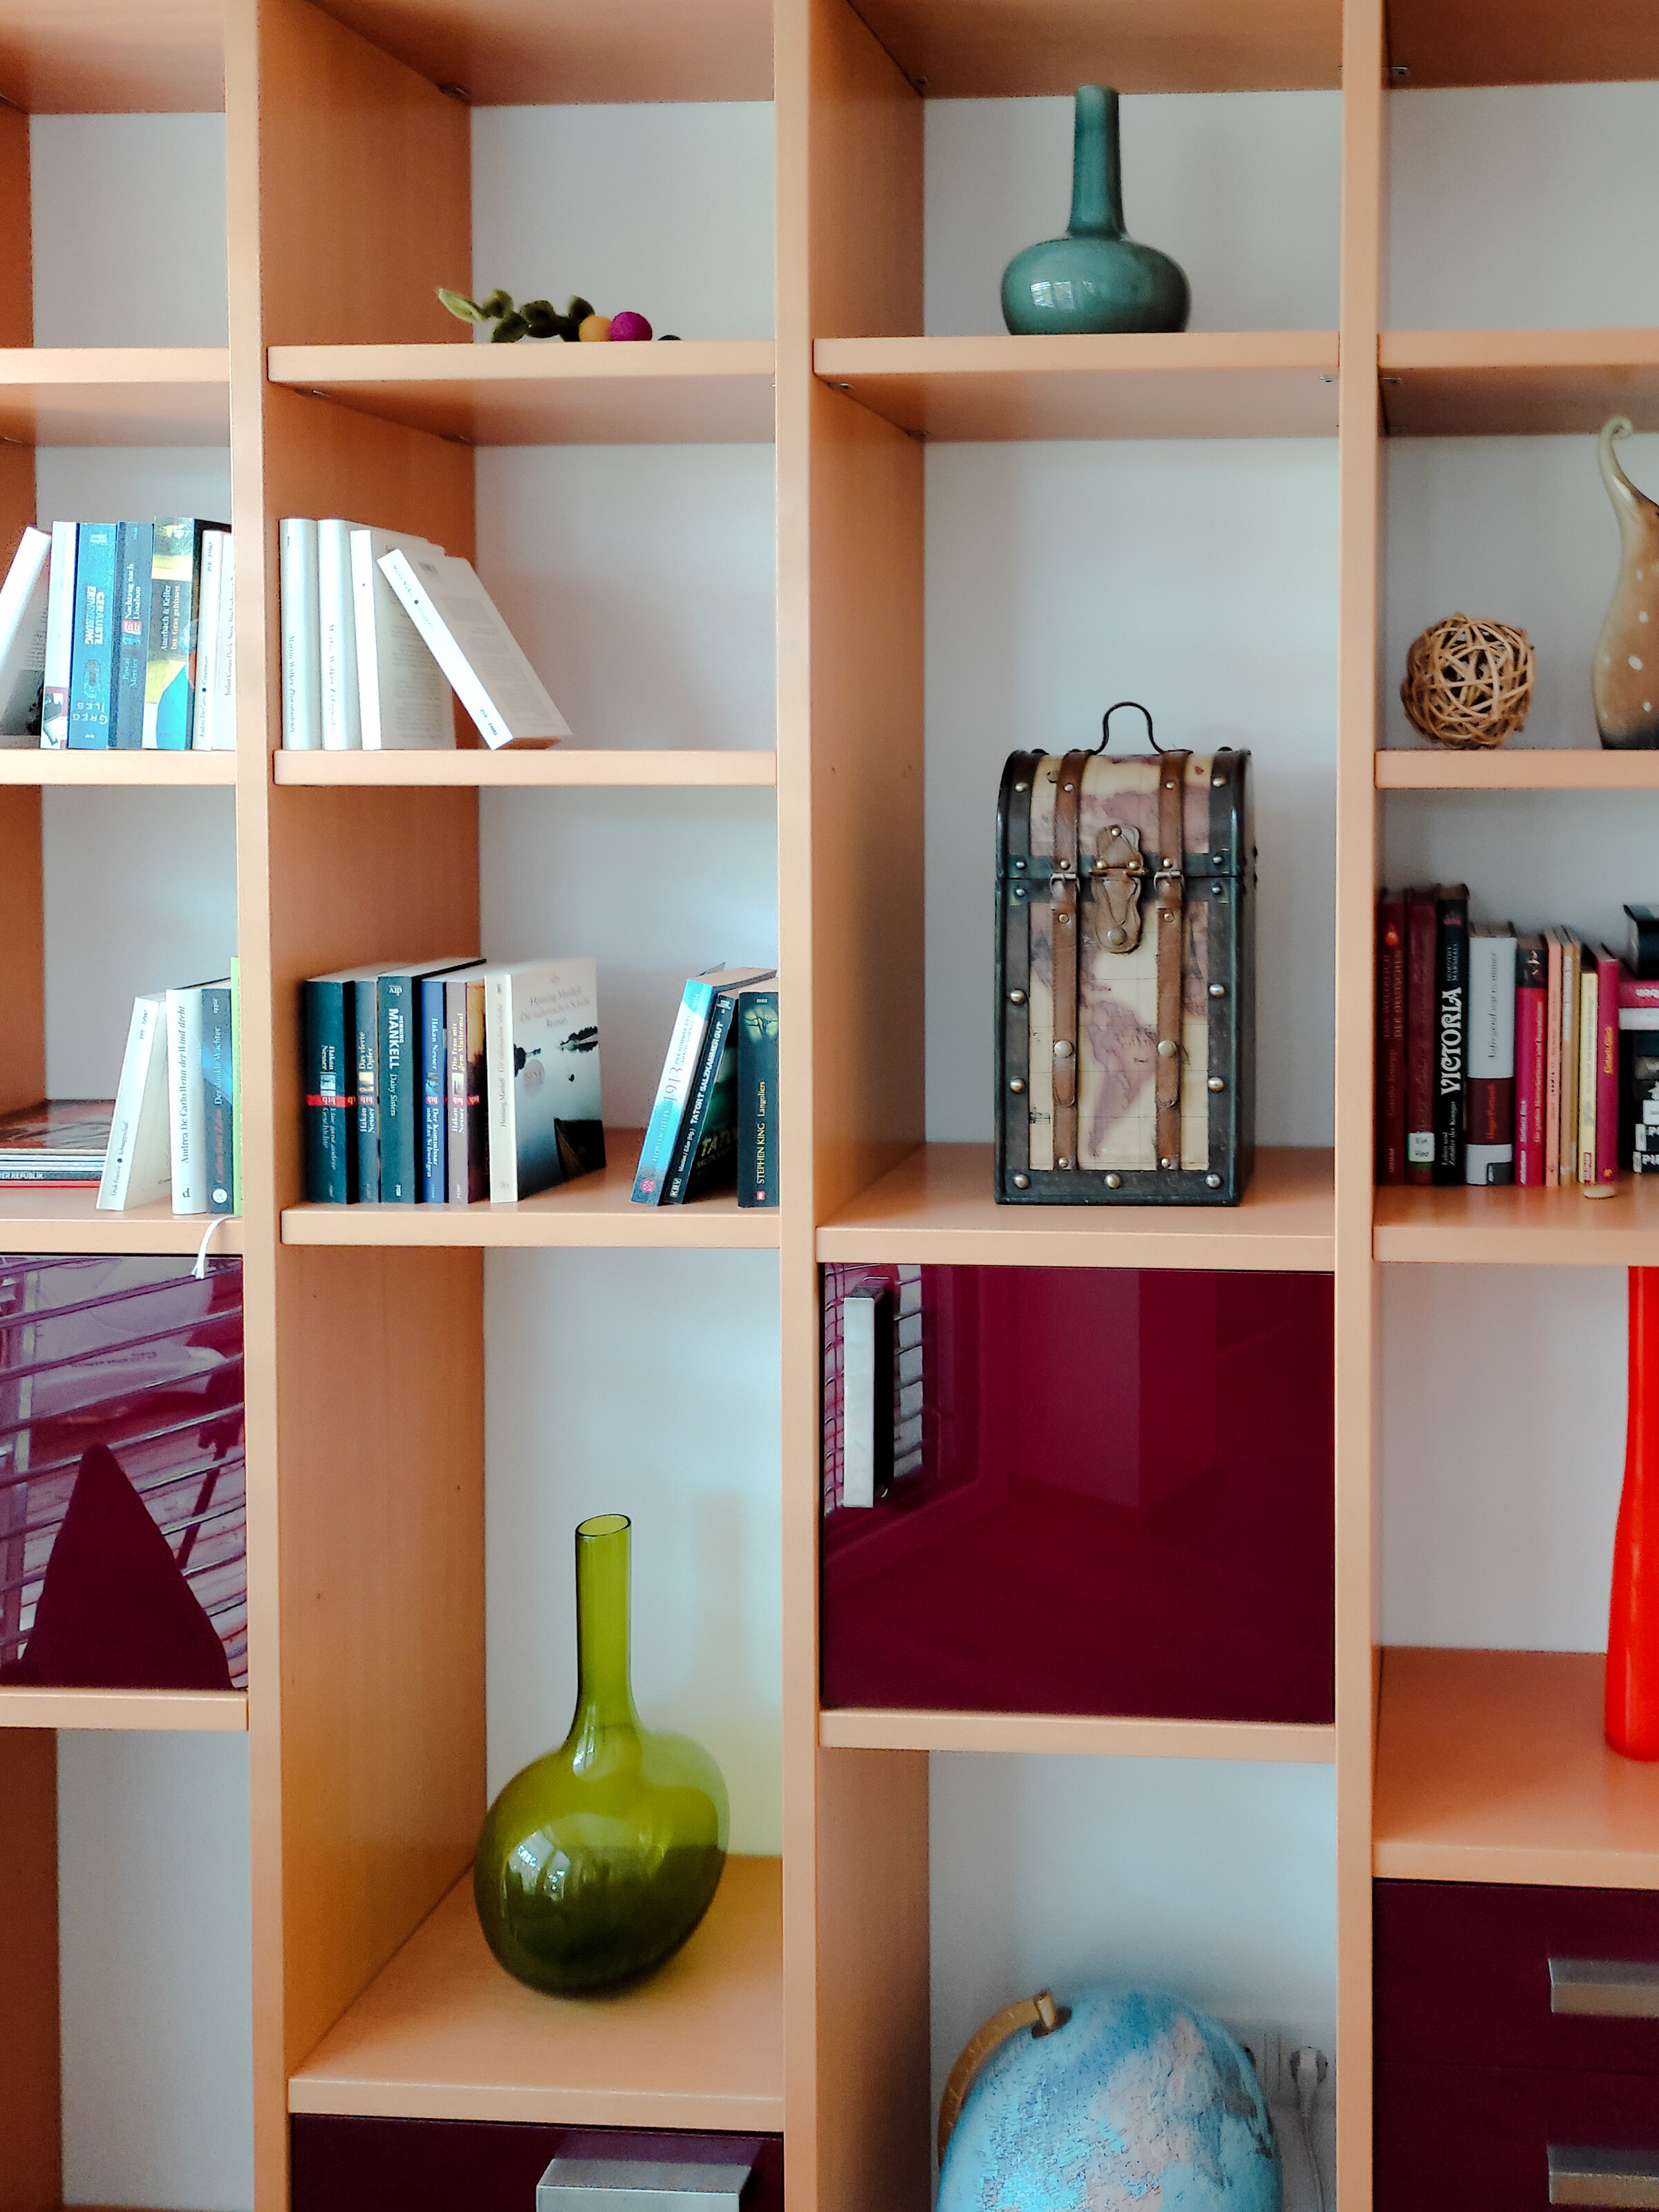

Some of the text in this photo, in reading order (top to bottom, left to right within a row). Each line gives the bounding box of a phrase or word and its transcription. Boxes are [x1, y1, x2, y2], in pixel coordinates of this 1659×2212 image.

[124, 563, 135, 619] Nachtzug nach
[132, 586, 141, 620] Lissabon
[161, 585, 171, 606] Keller
[171, 585, 180, 617] gebissen
[84, 585, 97, 645] ERINNERUNG
[95, 592, 104, 645] GERAUBTE
[171, 618, 179, 635] Gras
[160, 616, 170, 652] Auerbach
[73, 713, 108, 725] GREG
[77, 702, 105, 713] ILES
[1441, 986, 1463, 1096] VICTORIA
[388, 1008, 400, 1116] MANKELL Daisy Sisters
[690, 1092, 705, 1125] TATORT
[700, 1021, 725, 1092] SALZKAMMERGUT
[177, 1006, 189, 1164] Andrea De Carlo Wenn der Wind dreht
[214, 1091, 222, 1105] Der
[663, 1067, 683, 1102] 1913
[756, 1081, 767, 1184] STEPHEN KING Langoliers
[669, 1177, 682, 1198] KBV
